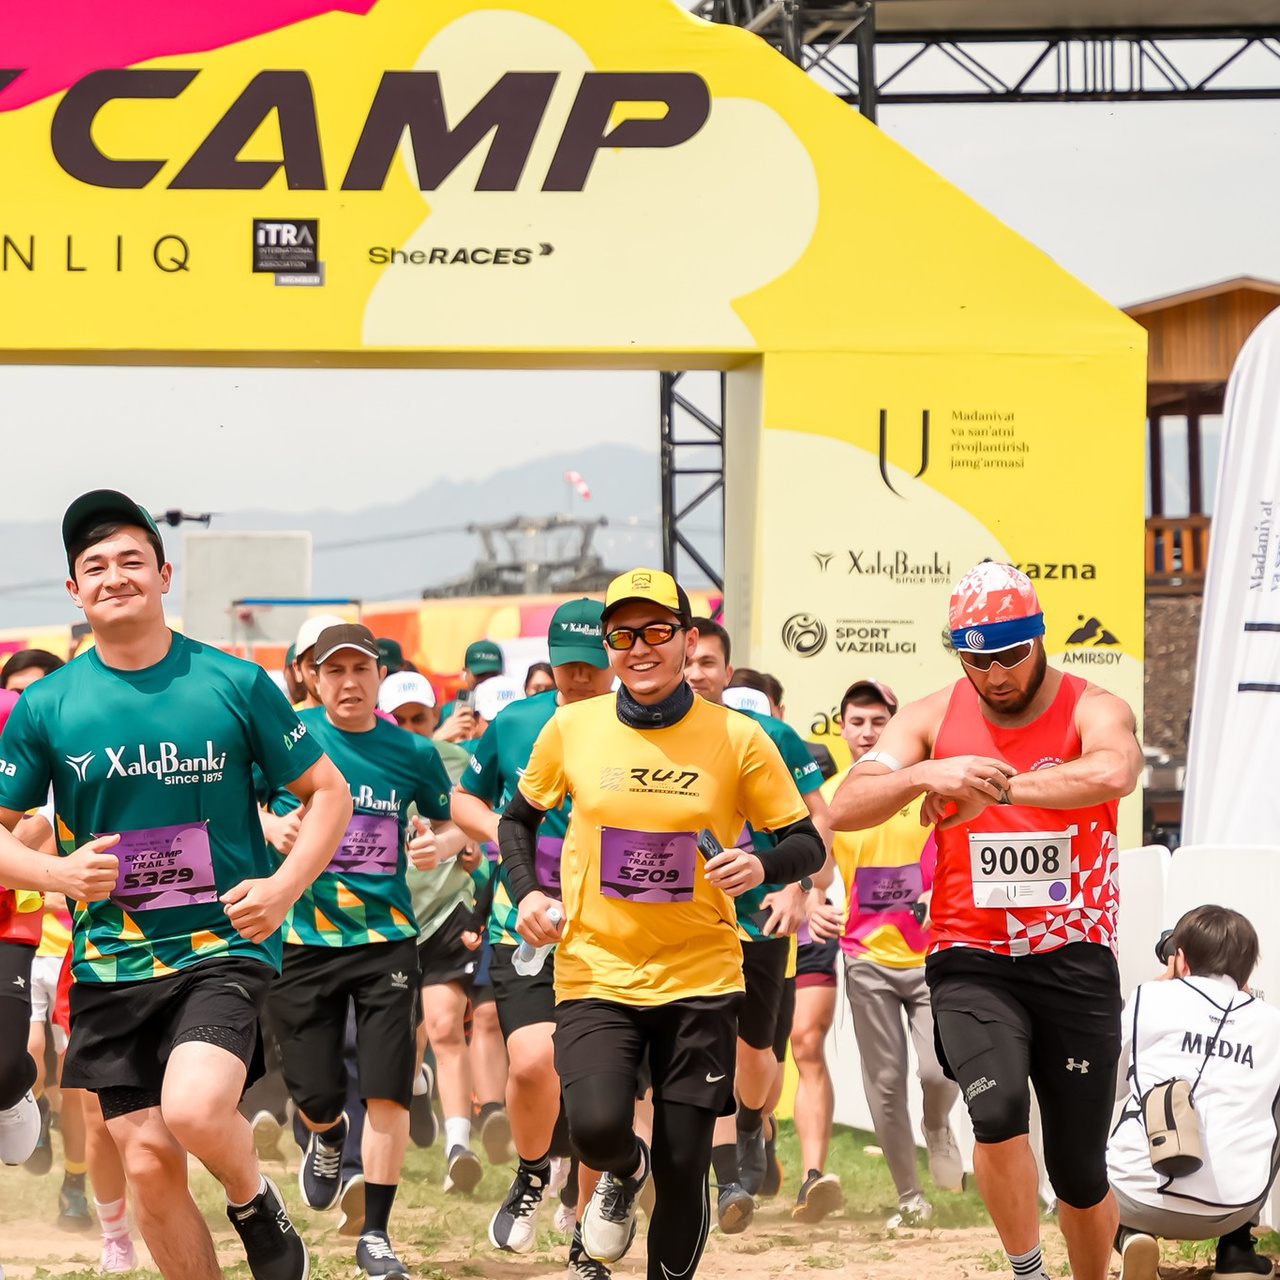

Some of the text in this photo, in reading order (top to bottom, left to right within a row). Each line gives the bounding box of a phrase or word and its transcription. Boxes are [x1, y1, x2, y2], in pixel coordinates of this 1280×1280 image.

[51, 68, 712, 192] CAMP
[369, 246, 533, 265] SheRACES
[951, 410, 1015, 422] Madaniyat
[951, 428, 965, 437] va
[951, 441, 1030, 454] rivojlantirish
[848, 549, 951, 579] XalqBanki
[836, 627, 890, 639] SPORT
[836, 641, 916, 654] VAZIRLIGI
[1063, 652, 1123, 665] AMIRSOY
[104, 740, 227, 780] XalqBanki
[164, 771, 223, 786] since 1875
[124, 850, 183, 863] SKY CAMP
[340, 845, 387, 857] 5377
[624, 850, 642, 858] SKY
[132, 861, 164, 870] TRAIL
[628, 858, 655, 866] TRAIL
[981, 845, 1060, 875] 9008
[122, 868, 194, 890] 5329
[617, 866, 680, 883] 5209
[1181, 1031, 1254, 1069] MEDIA
